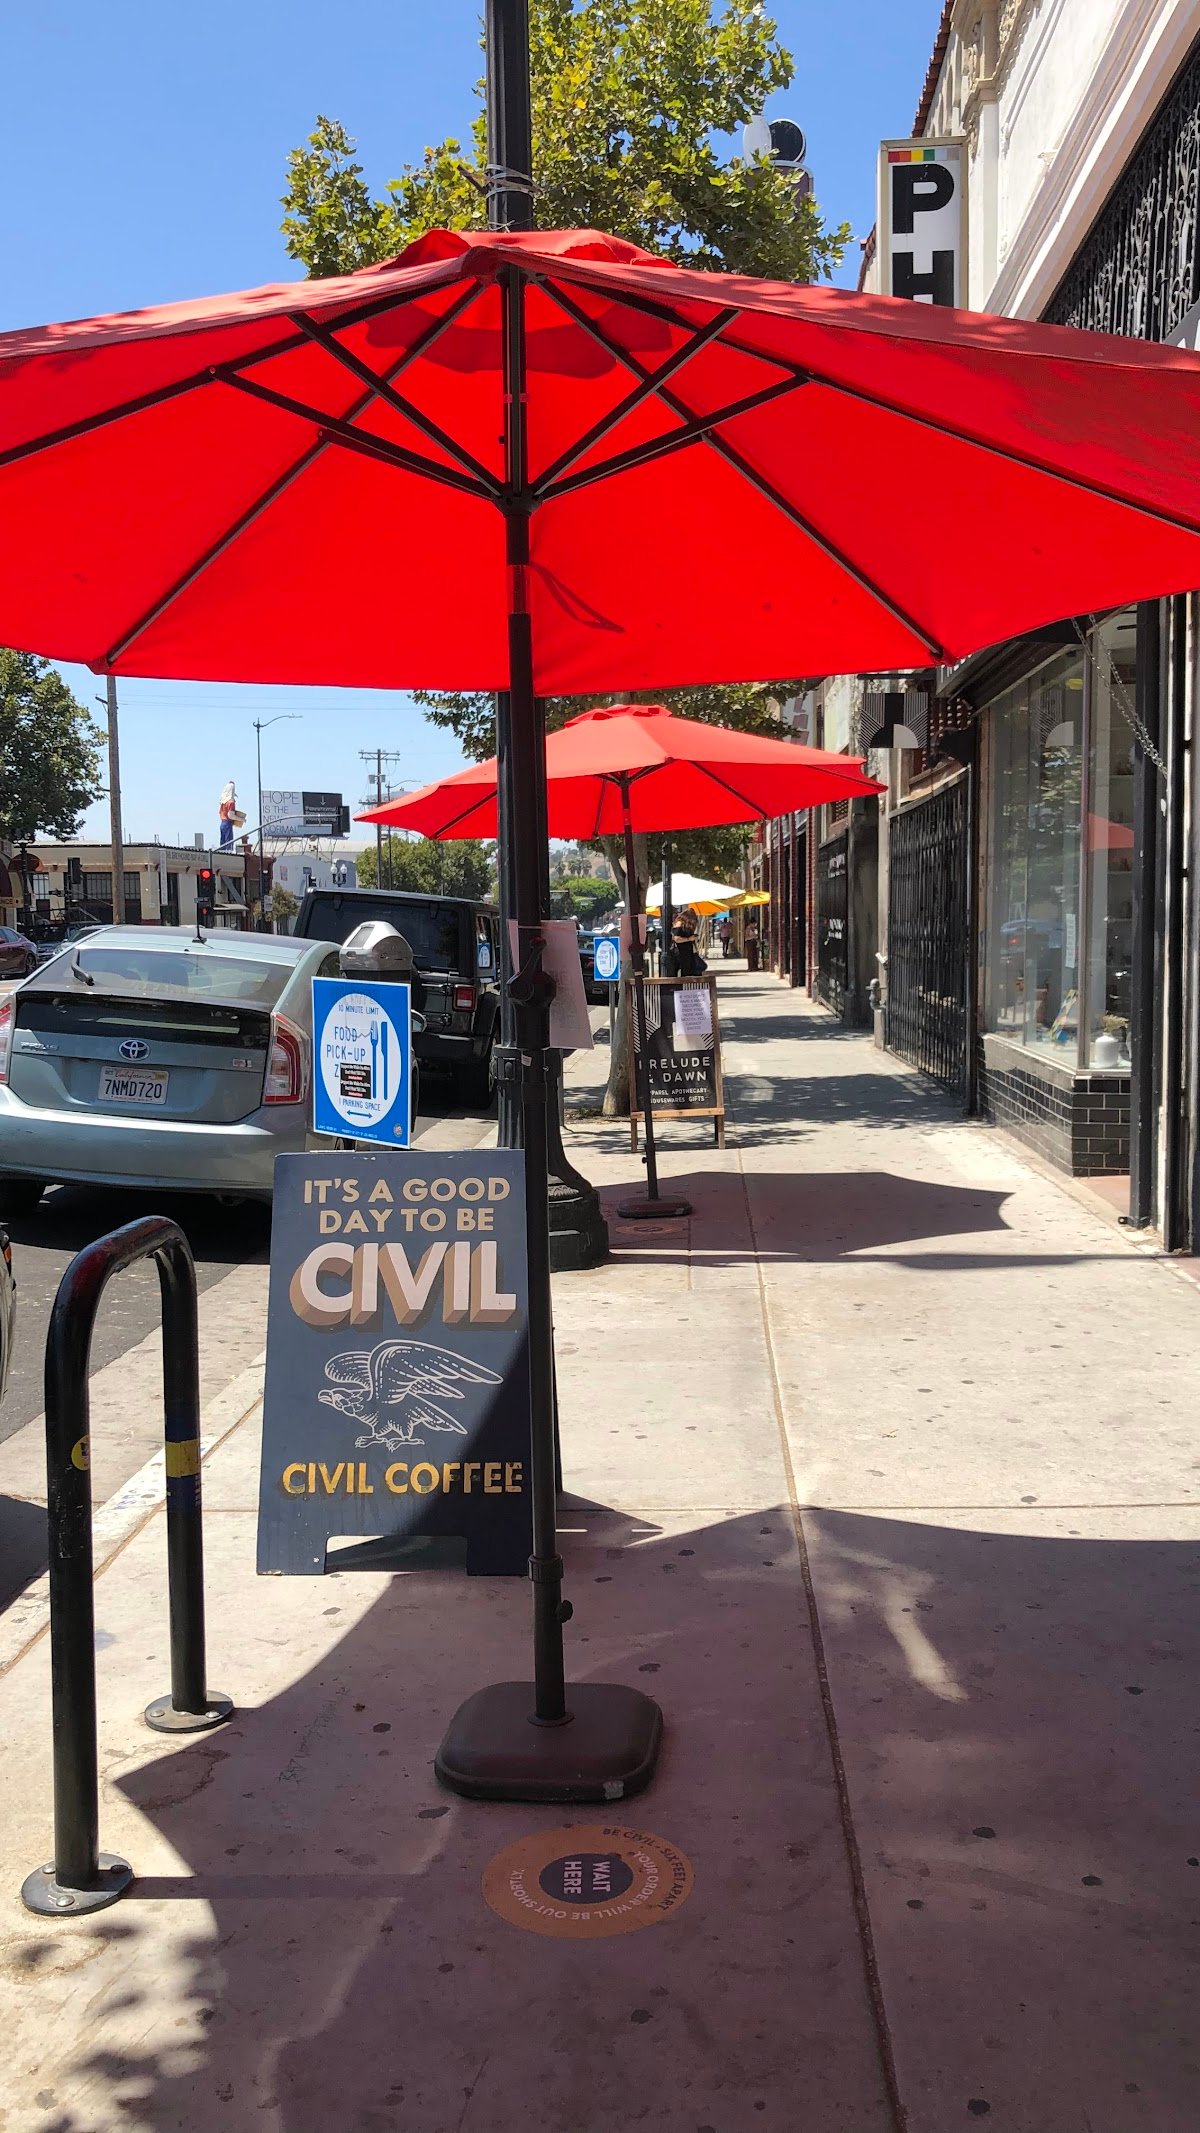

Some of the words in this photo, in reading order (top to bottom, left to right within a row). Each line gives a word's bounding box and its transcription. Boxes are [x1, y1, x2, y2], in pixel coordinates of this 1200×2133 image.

[262, 791, 300, 804] HOPE
[263, 806, 271, 814] IS
[274, 806, 289, 814] THE
[263, 825, 298, 834] NORMAL
[345, 1005, 363, 1013] MINUTE
[366, 1007, 379, 1015] LIMIT
[334, 1026, 357, 1042] FOOD
[326, 1044, 366, 1062] PICK-UP
[663, 1071, 707, 1083] DAWN
[104, 1079, 162, 1099] 7NMD720
[342, 1099, 363, 1108] PARKING
[364, 1102, 381, 1111] SPACE
[303, 1178, 359, 1204] IT'S
[368, 1179, 394, 1203] A
[402, 1177, 511, 1202] GOOD
[319, 1208, 393, 1234] DAY
[400, 1207, 447, 1232] TO
[456, 1207, 494, 1231] BE
[289, 1240, 517, 1326] CIVIL
[282, 1462, 374, 1494] CIVIL
[384, 1462, 523, 1494] COFFEE
[602, 1828, 620, 1837] BE
[624, 1831, 655, 1847] CIVIL
[633, 1850, 658, 1874] YOUR
[660, 1848, 679, 1862] SIX
[563, 1861, 582, 1895] HERE
[592, 1861, 611, 1893] WAIT
[671, 1862, 686, 1883] FEET
[630, 1875, 659, 1907] ORDER
[656, 1883, 685, 1911] APART
[534, 1906, 567, 1919] OUT
[571, 1912, 590, 1920] BE
[594, 1904, 632, 1919] WILL
